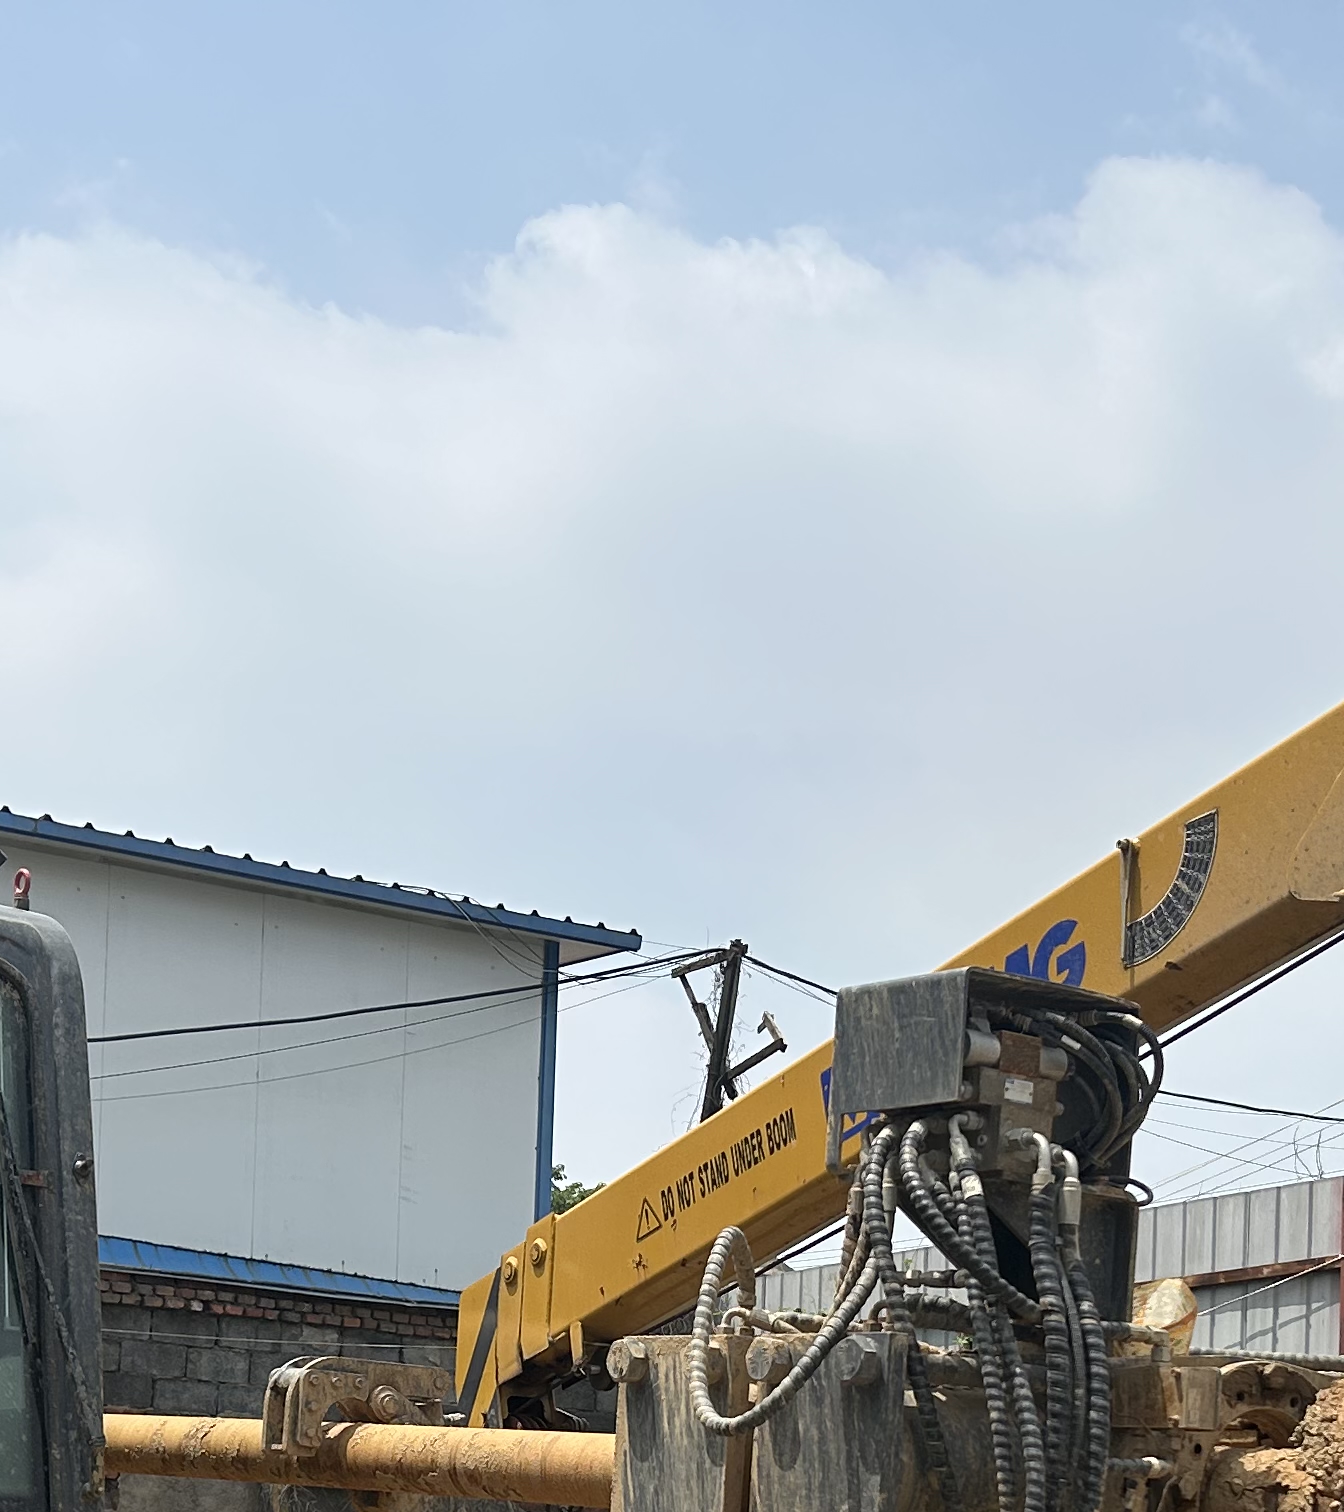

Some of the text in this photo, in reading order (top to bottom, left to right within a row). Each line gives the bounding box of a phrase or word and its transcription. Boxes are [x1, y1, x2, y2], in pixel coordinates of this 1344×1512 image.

[661, 1107, 797, 1222] DO NOT STAND UNDER BOOM
